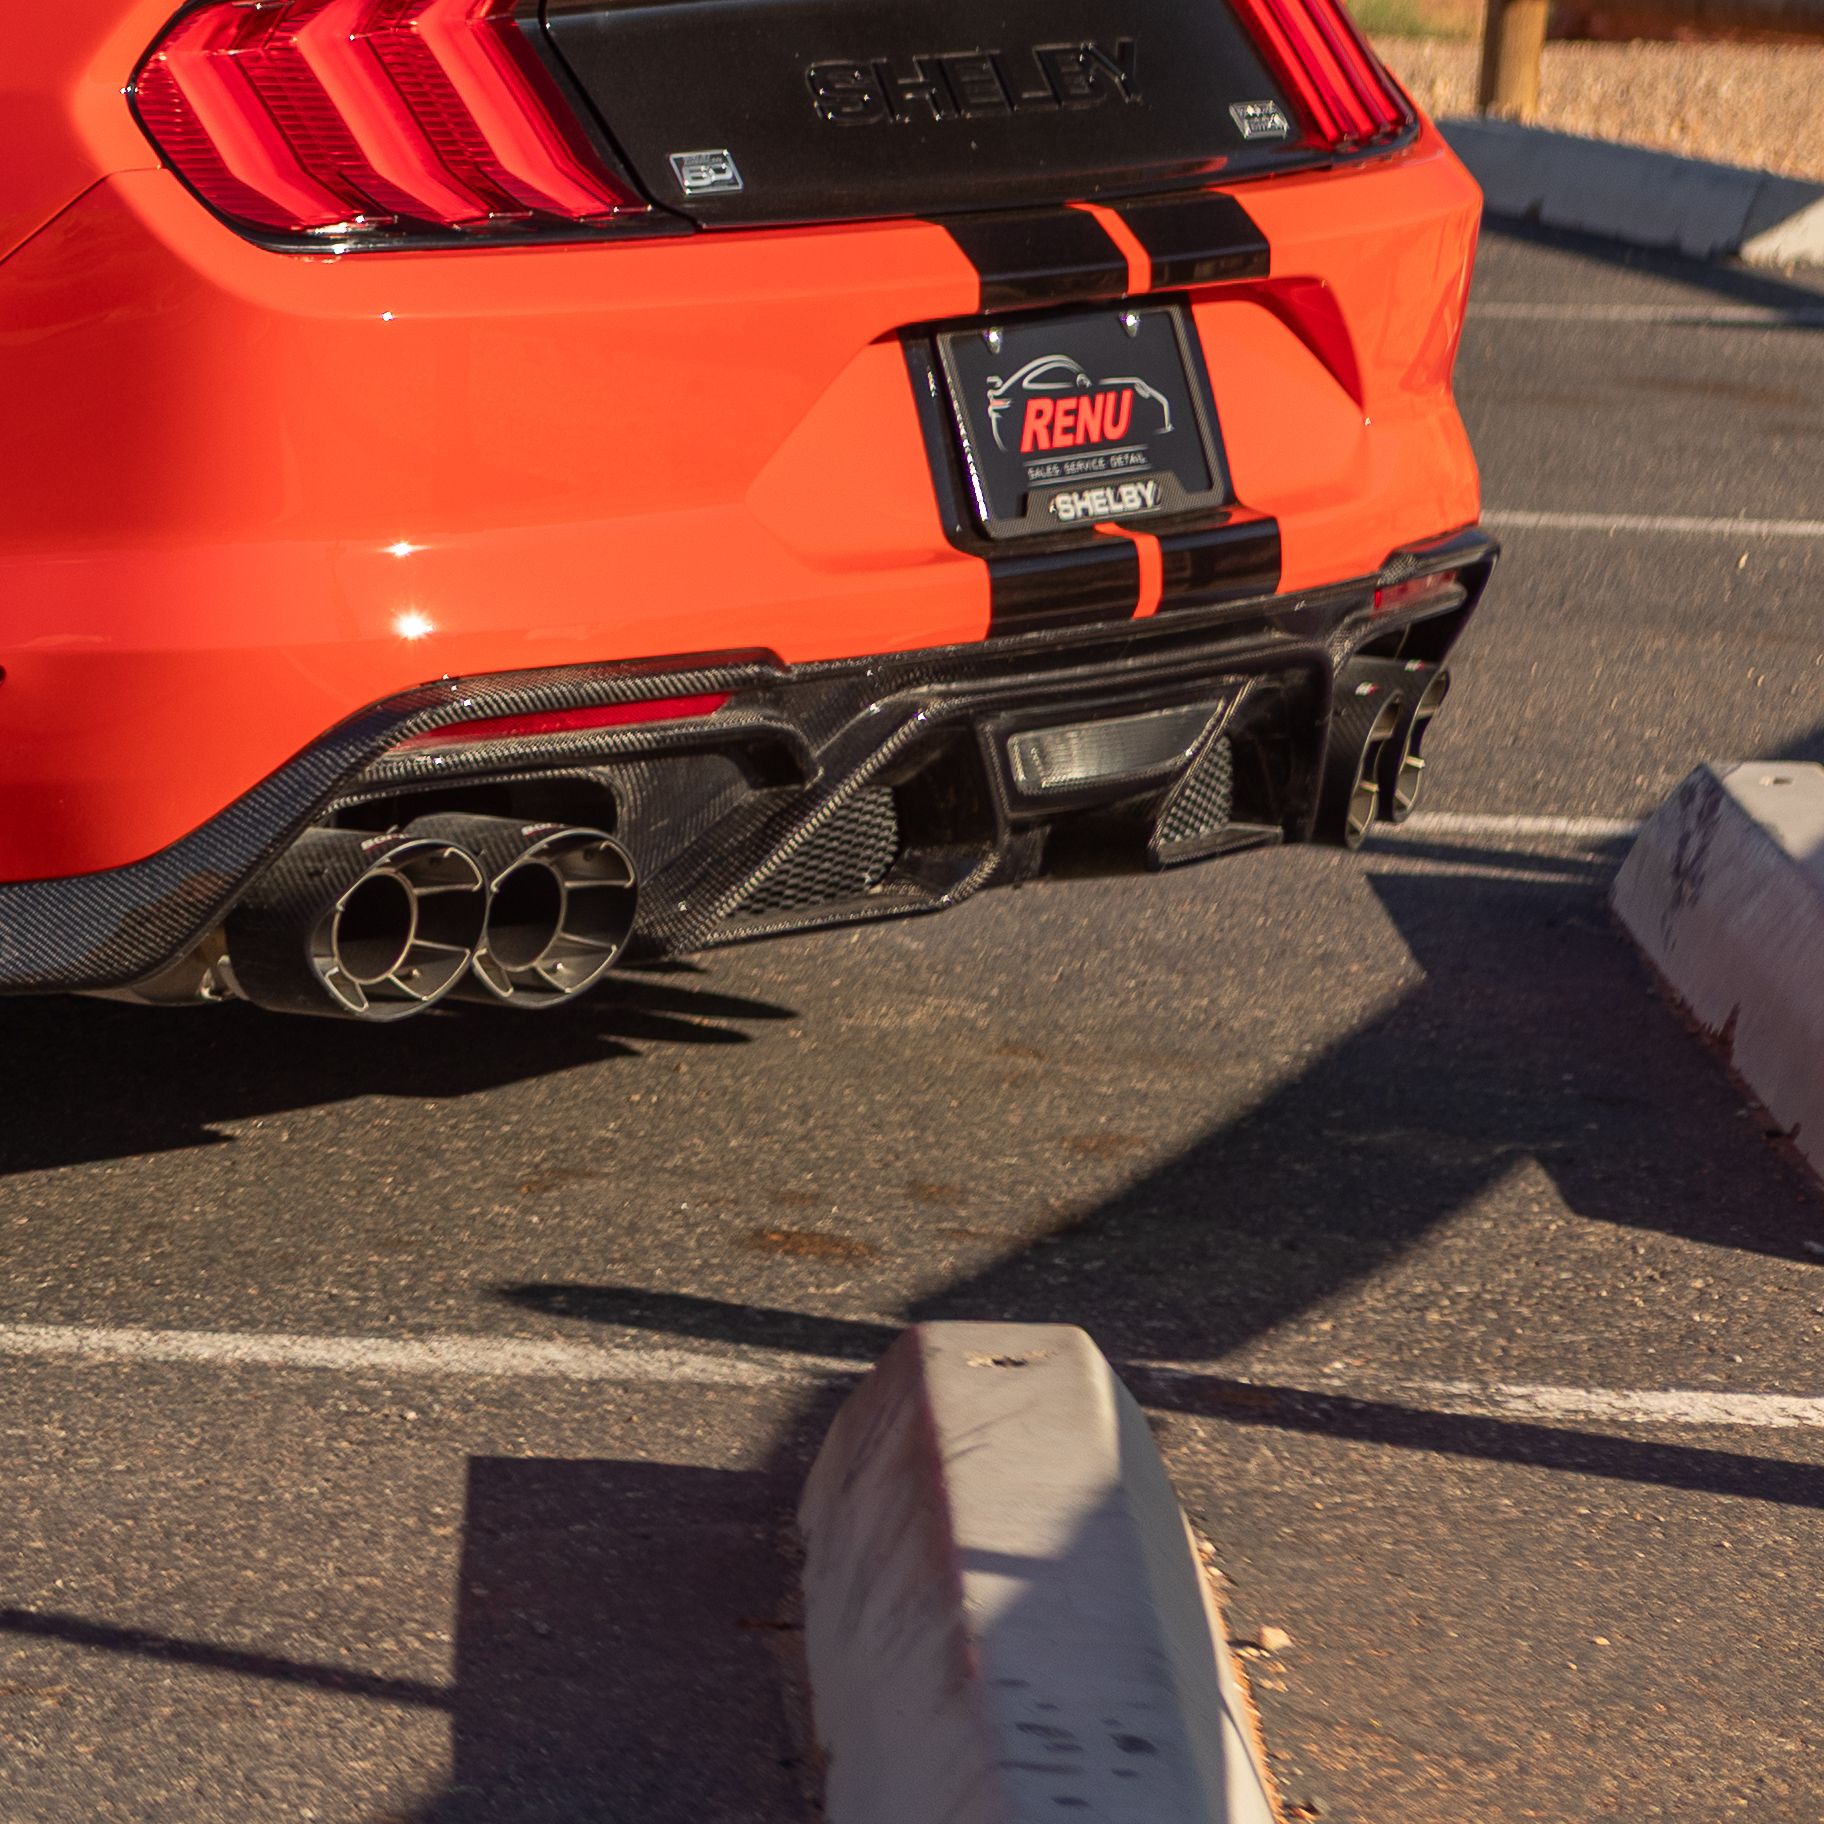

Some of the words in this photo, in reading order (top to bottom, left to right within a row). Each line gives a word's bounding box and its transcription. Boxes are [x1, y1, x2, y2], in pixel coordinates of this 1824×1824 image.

[806, 38, 1142, 123] SHELBY
[1019, 388, 1135, 454] RENU
[1027, 463, 1061, 480] SALES
[1063, 457, 1105, 475] SERVICE
[1109, 452, 1148, 469] DETAIL
[1054, 480, 1157, 522] SHELBY
